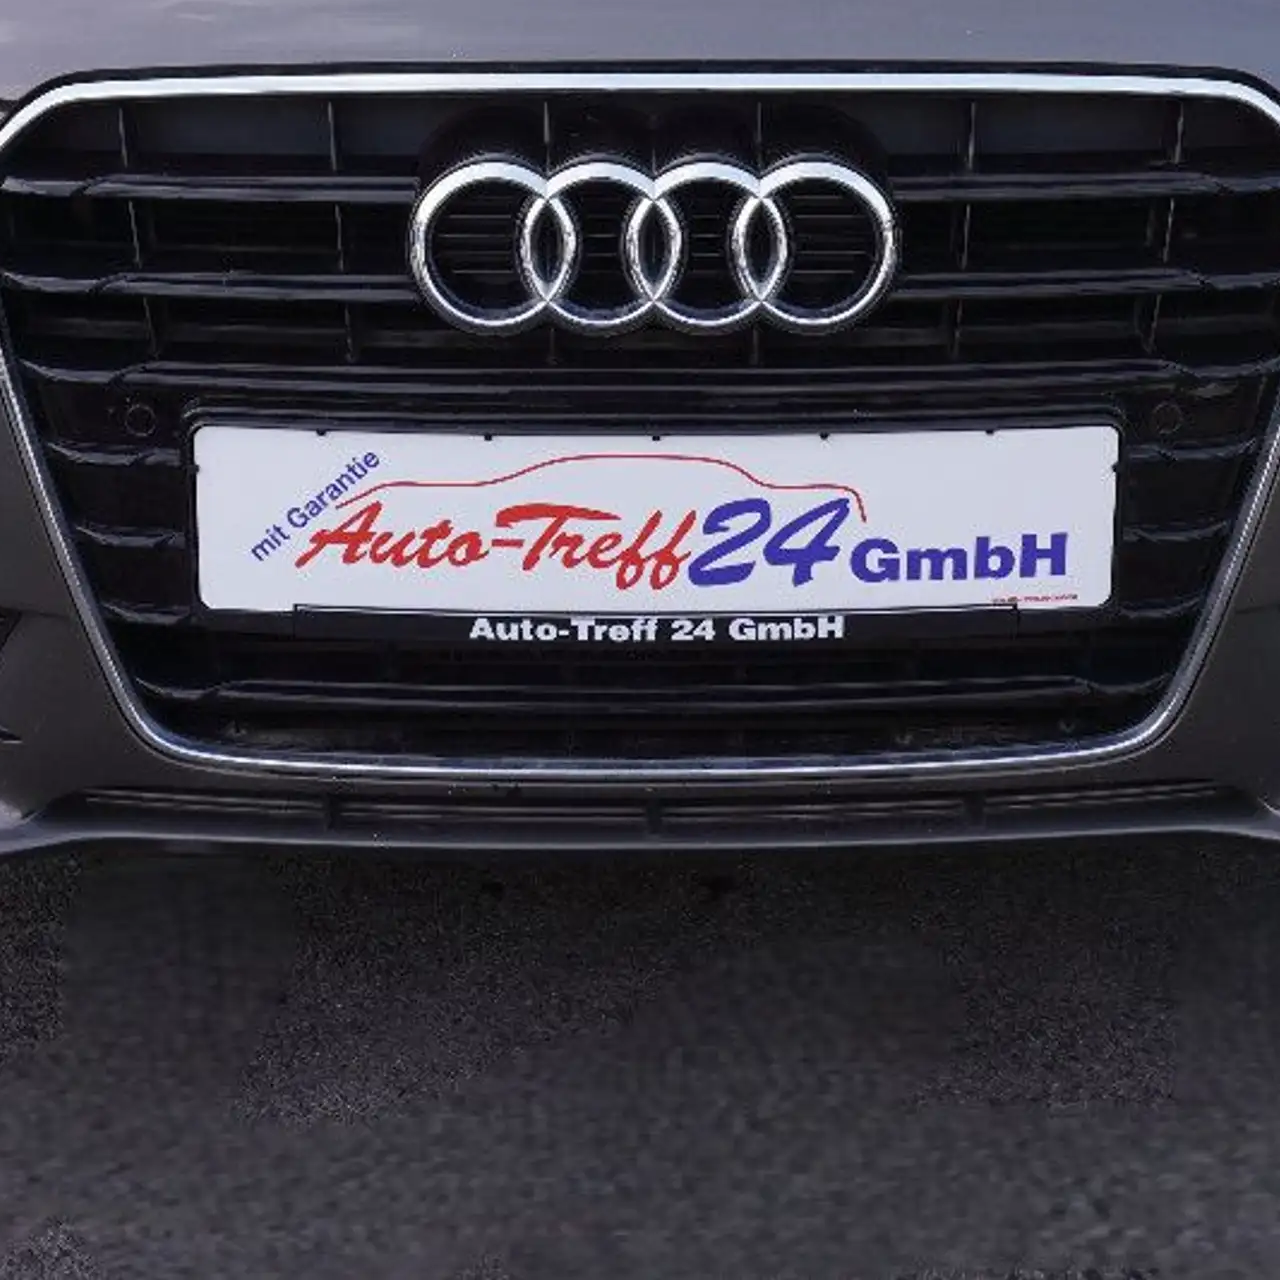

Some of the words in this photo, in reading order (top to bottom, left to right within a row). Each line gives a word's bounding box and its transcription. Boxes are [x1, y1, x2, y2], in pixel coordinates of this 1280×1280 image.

[250, 527, 291, 563] mit
[286, 448, 381, 531] Garantie
[850, 531, 1069, 584] GmbH
[469, 617, 658, 642] Auto-Treff
[670, 617, 716, 642] 24
[728, 615, 846, 641] GmbH
